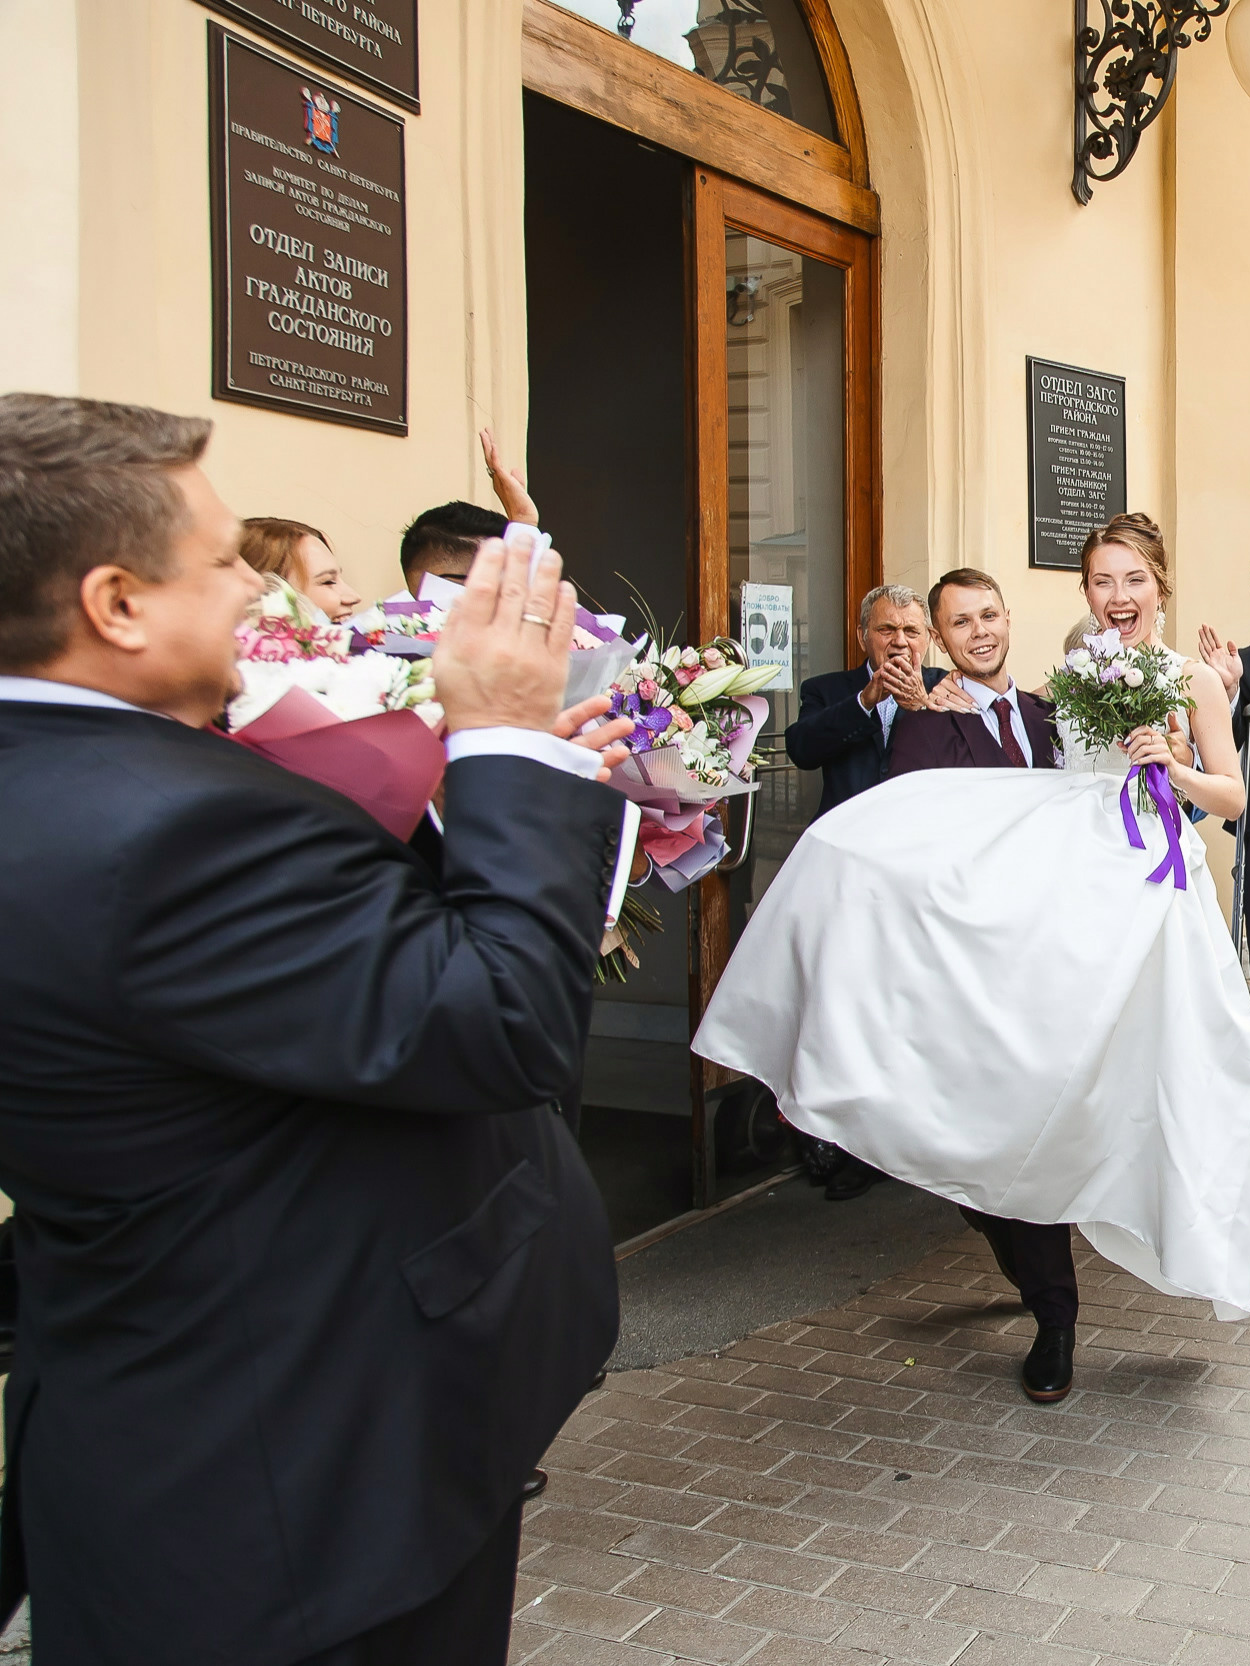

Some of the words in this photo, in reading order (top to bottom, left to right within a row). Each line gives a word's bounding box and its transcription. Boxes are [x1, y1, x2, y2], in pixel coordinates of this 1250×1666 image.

[353, 5, 403, 45] РАЙОНА
[231, 121, 313, 165] ПРАВИТЕЛЬСТВО
[317, 158, 400, 203] САНКТ-ПЕТЕРБУРГА
[244, 169, 285, 194] ЗАПИСИ
[288, 186, 320, 207] АКТОВ
[322, 200, 392, 236] ГРАЖДАНСКОГО
[272, 166, 317, 193] КОМИТЕТ
[320, 185, 335, 200] ПО
[337, 192, 369, 214] ДЕЛАМ
[294, 203, 351, 233] СОСТОЯНИЯ
[249, 223, 315, 263] ОТДЕЛ
[323, 248, 389, 289] ЗАПИСИ
[294, 265, 353, 300] АКТОВ
[245, 275, 392, 337] ГРАЖДАНСКОГО
[268, 310, 374, 357] СОСТОЯНИЯ
[248, 351, 347, 385] ПЕТРОГРАДСКОГО
[351, 376, 390, 396] РАЙОНА
[269, 373, 373, 407] САНКТ-ПЕТЕРБУРГА
[1041, 375, 1082, 396] ОТДЕЛ
[1086, 384, 1117, 403] ЗАГС
[1040, 391, 1119, 417] ПЕТРОГРАДСКОГО
[1063, 408, 1098, 425] РАЙОНА
[1050, 424, 1075, 437] ПРИЕМ
[1077, 429, 1111, 443] ГРАЖДАН
[1051, 464, 1076, 476] ПРИЕМ
[1078, 468, 1112, 481] ГРАЖДАН
[1056, 476, 1107, 491] НАЧАЛЬНИКОМ
[1058, 487, 1086, 498] ОТДЕЛА
[1088, 491, 1106, 500] ЗАГС
[758, 594, 780, 602] ДОБРО
